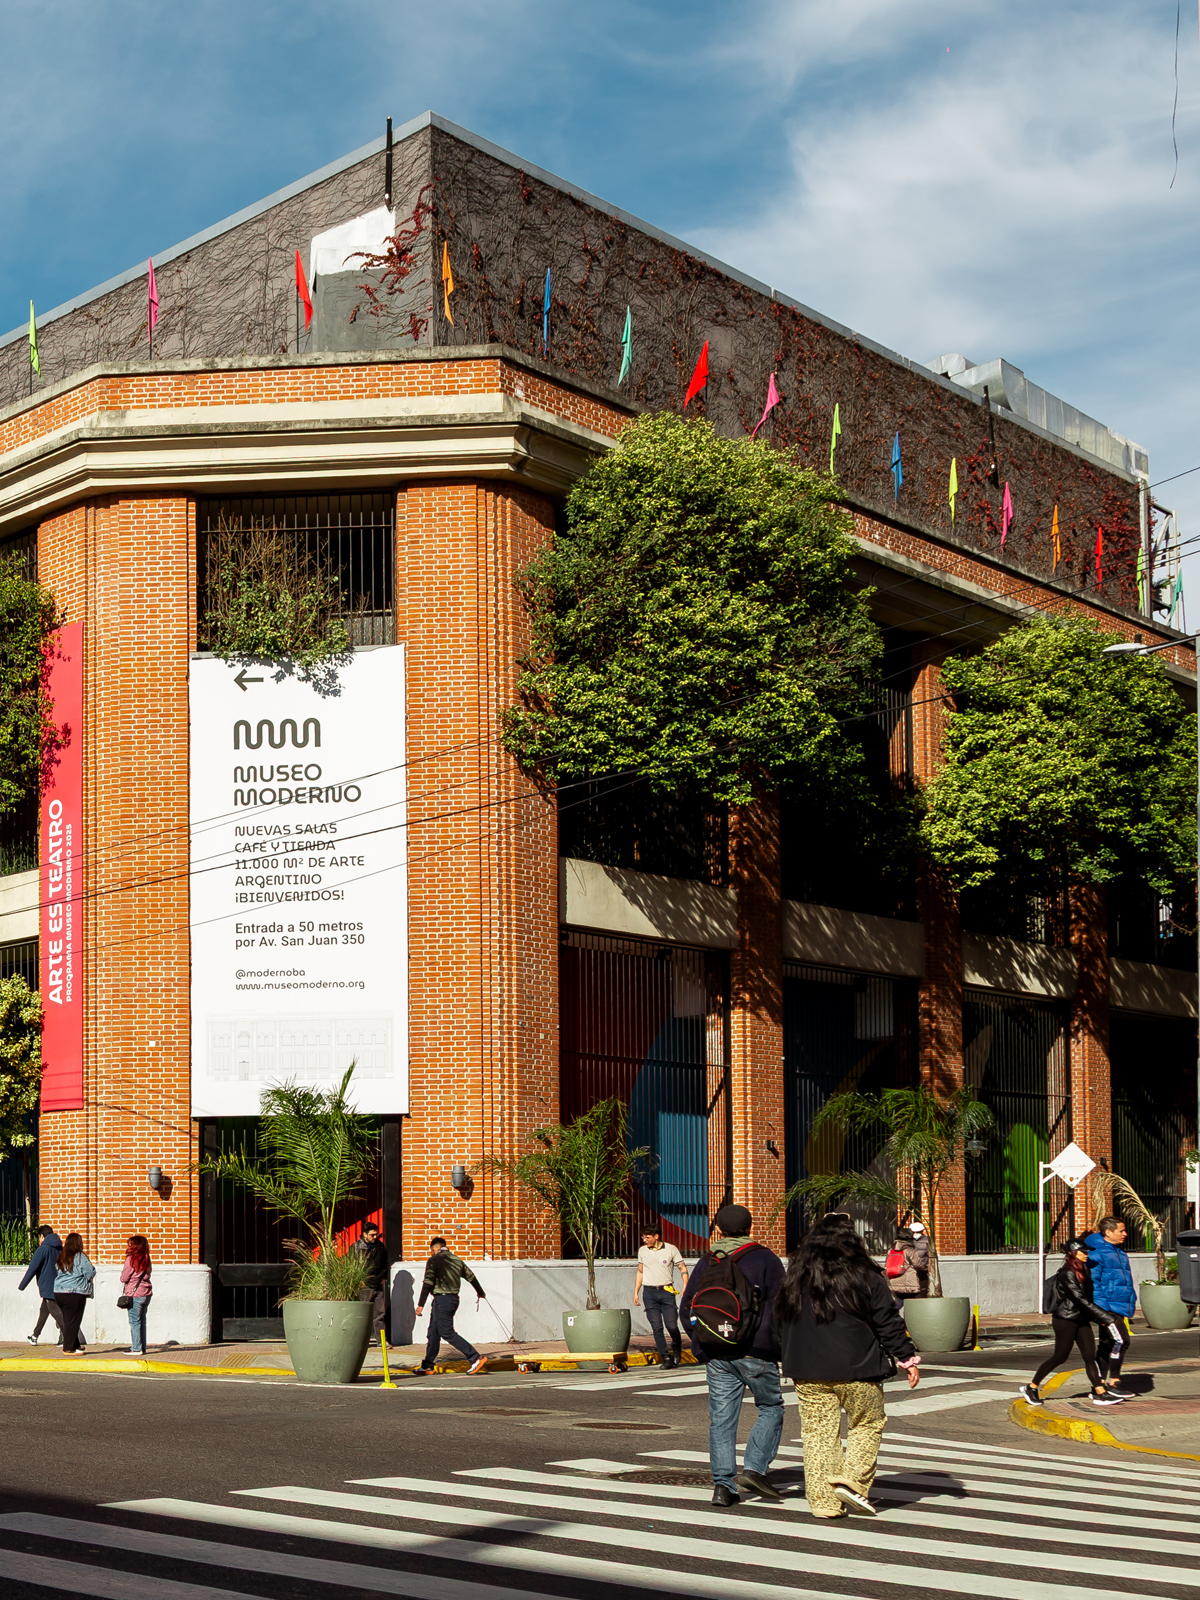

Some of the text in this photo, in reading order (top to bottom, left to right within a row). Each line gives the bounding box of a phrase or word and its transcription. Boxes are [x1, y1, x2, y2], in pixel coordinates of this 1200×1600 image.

[234, 764, 322, 783] MUSEO
[234, 784, 362, 806] MODERNO
[234, 823, 337, 837] NUEVAS SALAS
[234, 840, 336, 853] CAFÉ Y TIENDA
[234, 858, 278, 870] 11.000
[308, 856, 326, 868] DE
[329, 855, 365, 867] ARTE
[234, 874, 322, 888] ARGENTINO
[48, 799, 63, 1005] ARTE ES TEATRO
[235, 890, 345, 904] ¡BIENVENIDOS!
[235, 921, 364, 934] Entrada a 50 metros
[235, 934, 365, 950] por Av. San Juan 350
[235, 968, 306, 980] @modernoba
[235, 980, 365, 991] www.museomoderno.org
